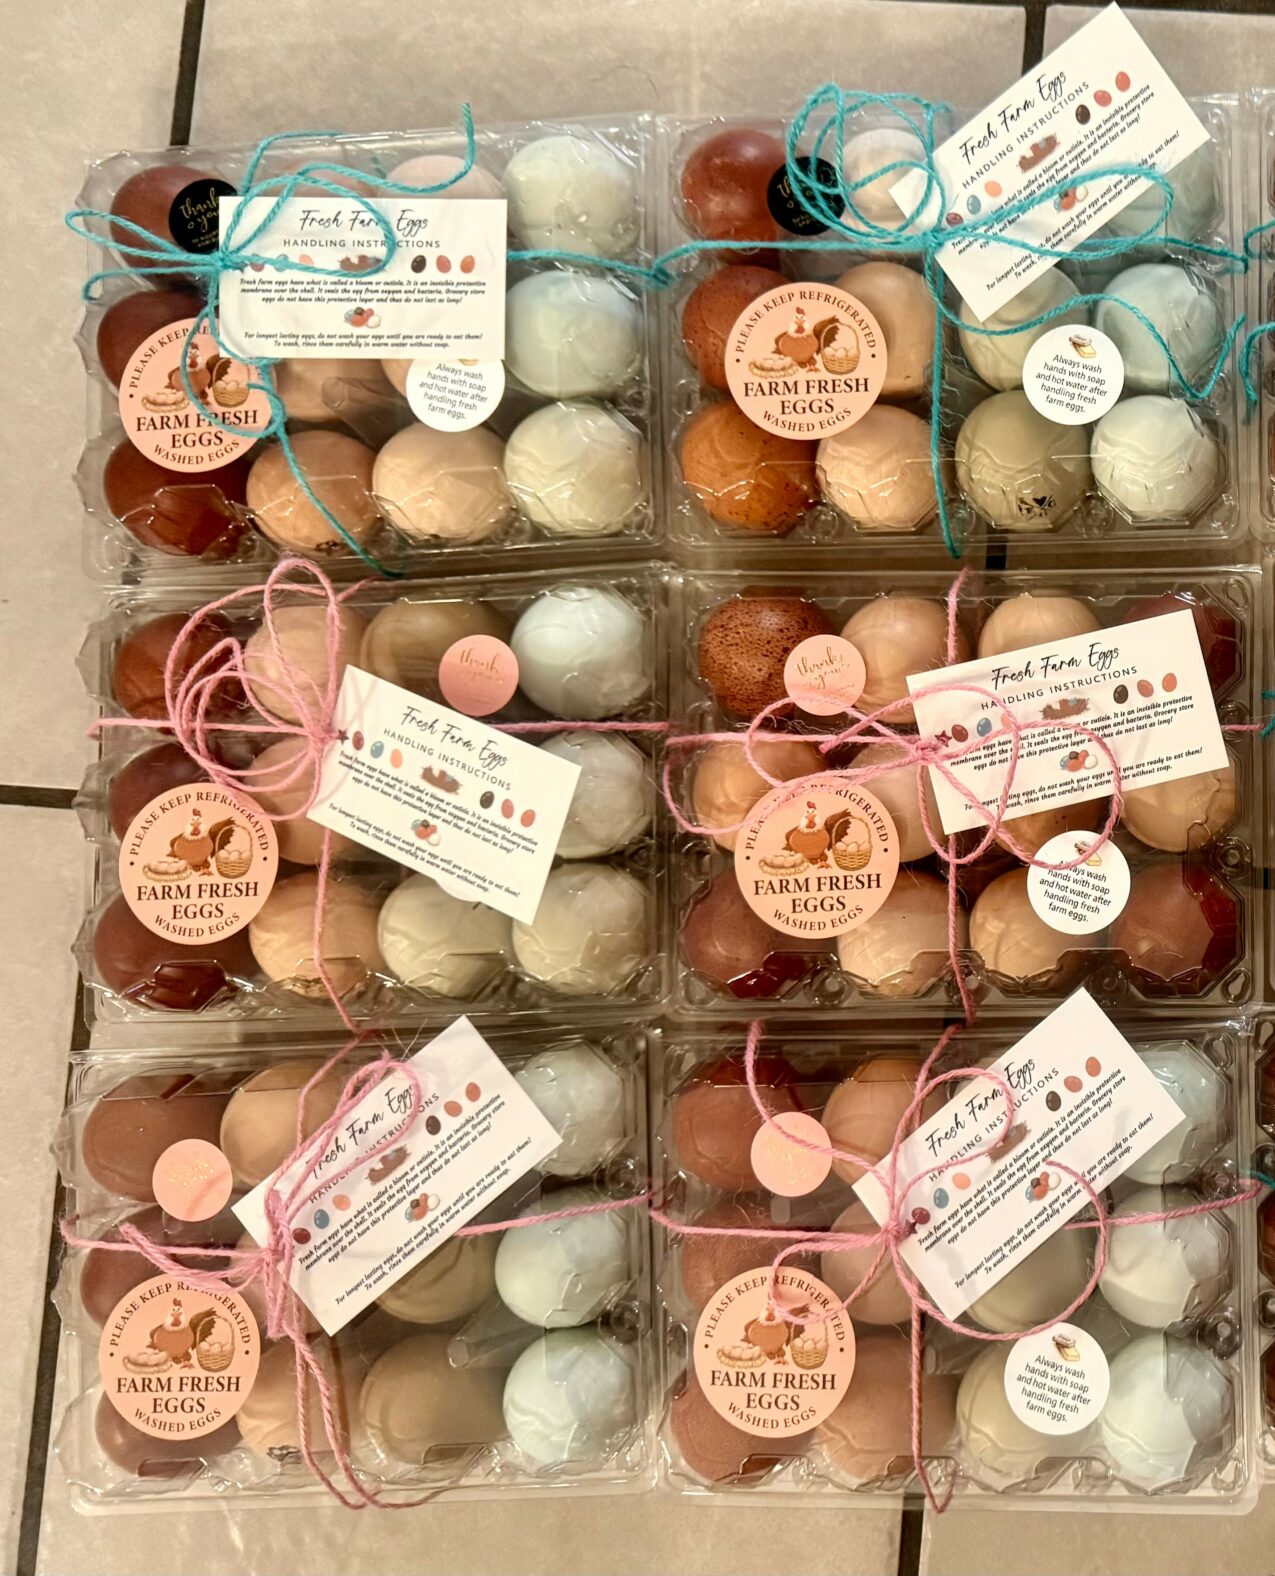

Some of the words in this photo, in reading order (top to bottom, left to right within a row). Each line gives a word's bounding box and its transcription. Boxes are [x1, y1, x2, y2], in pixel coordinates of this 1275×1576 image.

[958, 121, 998, 165] Fresh
[996, 98, 1035, 133] Farm
[1034, 71, 1066, 102] Eggs
[961, 143, 1014, 189] HANDLING
[1016, 81, 1089, 144] INSTRUCTIONS
[298, 209, 343, 231] Fresh
[395, 208, 429, 238] Eggs
[283, 238, 345, 247] HANDLING
[736, 311, 764, 353] PLEASE
[764, 292, 795, 311] KEEP
[800, 291, 876, 348] REFRIGERATED
[130, 346, 158, 388] PLEASE
[159, 328, 189, 347] KEEP
[744, 381, 798, 397] FARM
[805, 378, 869, 394] FRESH
[781, 399, 834, 415] EGGS
[136, 414, 189, 431] FARM
[763, 411, 815, 432] WASHED
[820, 408, 852, 430] EGGS
[154, 444, 204, 465] WASHED
[208, 439, 240, 462] EGGS
[171, 431, 224, 449] EGGS
[990, 659, 1035, 690] Fresh
[1039, 653, 1082, 679] Farm
[1087, 641, 1119, 672] Eggs
[1049, 665, 1137, 694] INSTRUCTIONS
[400, 704, 439, 735] Fresh
[440, 722, 475, 752] Farm
[478, 738, 507, 771] Eggs
[383, 727, 434, 756] HANDLING
[437, 752, 511, 790] INSTRUCTIONS
[130, 811, 159, 856] PLEASE
[160, 794, 192, 813] KEEP
[137, 884, 192, 900] FARM
[197, 882, 259, 898] FRESH
[754, 877, 810, 895] FARM
[816, 874, 882, 892] FRESH
[172, 903, 224, 920] EGGS
[791, 896, 846, 913] EGGS
[155, 915, 204, 937] WASHED
[209, 913, 240, 935] EGGS
[774, 909, 826, 930] WASHED
[831, 905, 863, 928] EGGS
[924, 1112, 965, 1157] Fresh
[964, 1087, 1003, 1122] Farm
[1003, 1058, 1035, 1090] Eggs
[344, 1111, 384, 1146] Farm
[110, 1301, 140, 1347] PLEASE
[140, 1283, 172, 1303] KEEP
[705, 1294, 735, 1338] PLEASE
[735, 1276, 767, 1296] KEEP
[116, 1377, 173, 1393] FARM
[178, 1376, 241, 1392] FRESH
[710, 1370, 766, 1388] FARM
[772, 1373, 836, 1389] FRESH
[152, 1397, 205, 1413] EGGS
[746, 1393, 800, 1411] EGGS
[134, 1409, 185, 1432] WASHED
[189, 1408, 221, 1431] EGGS
[728, 1402, 779, 1429] WASHED
[784, 1406, 816, 1428] EGGS
